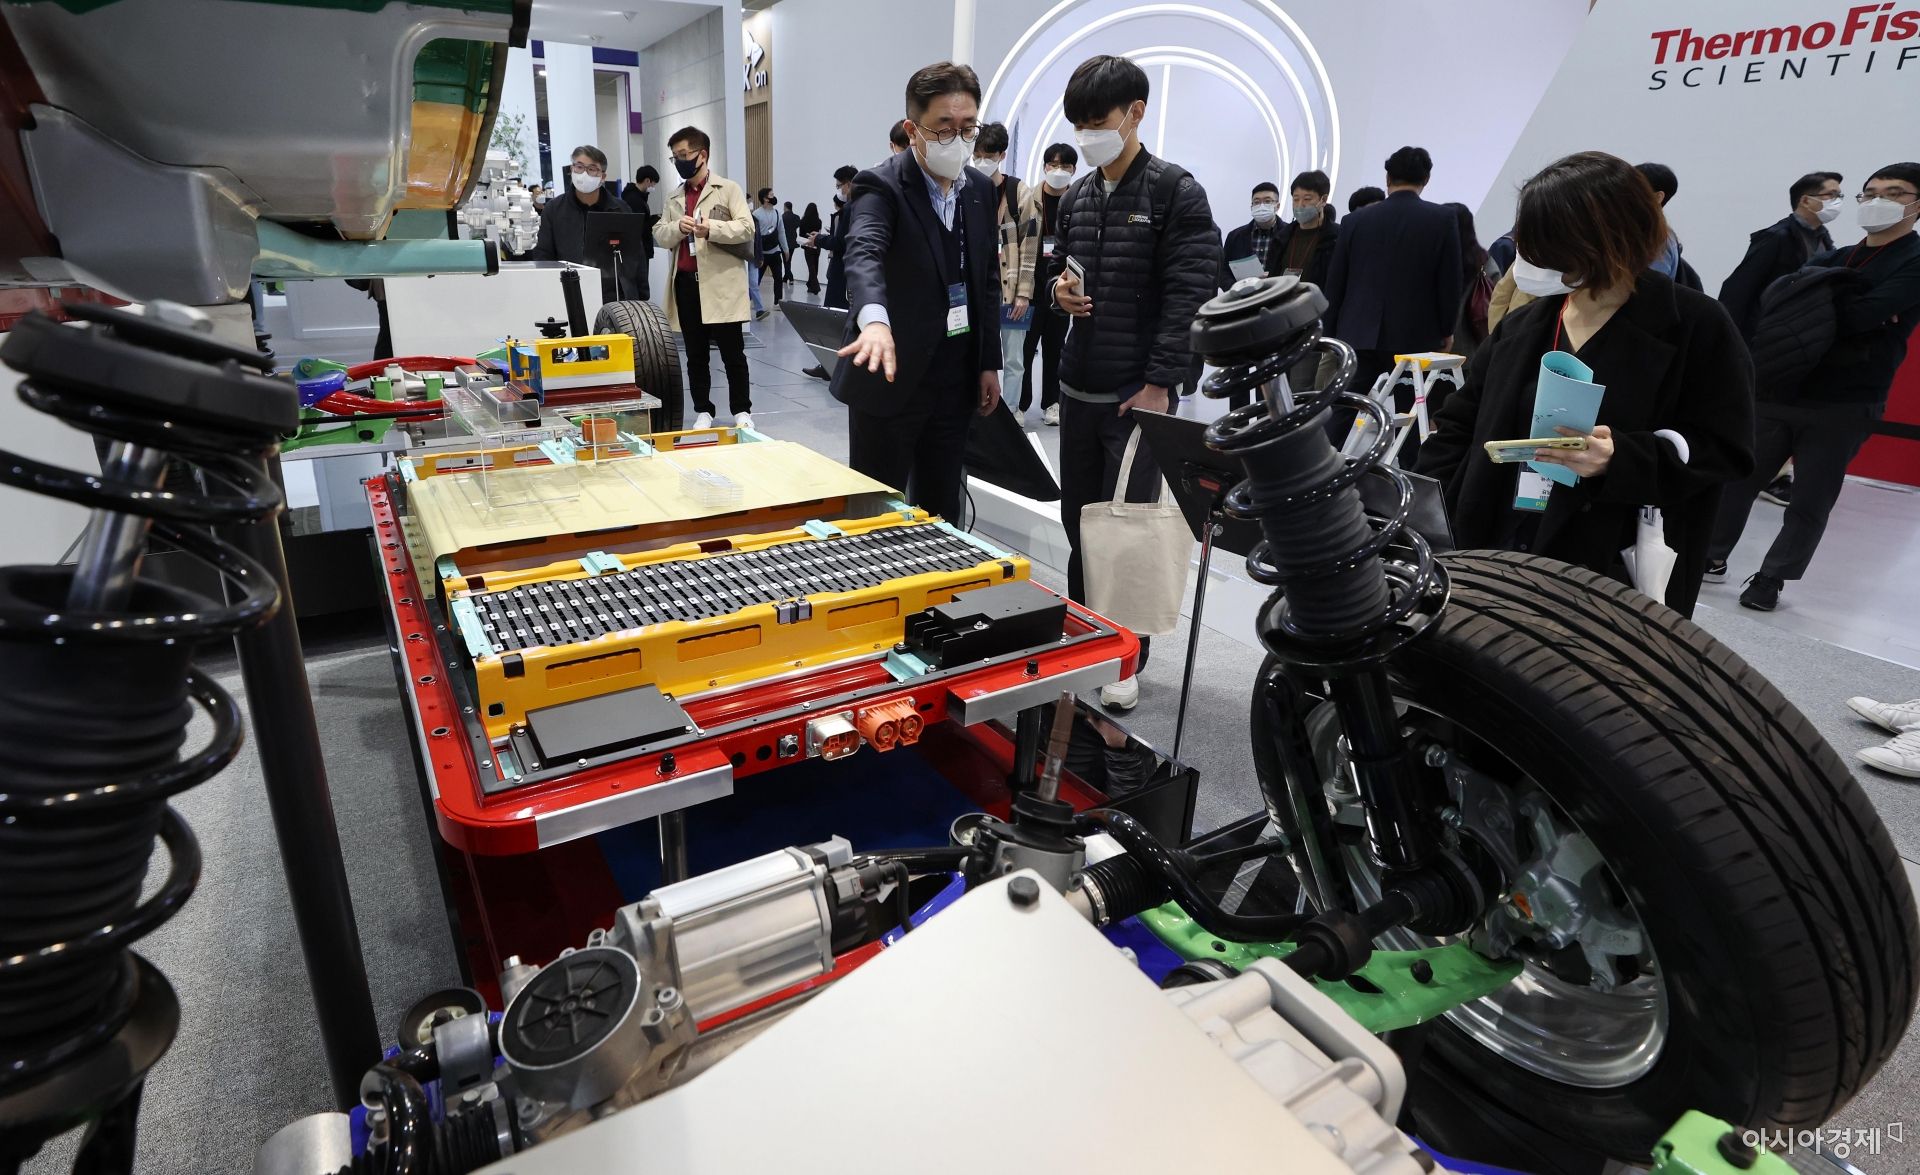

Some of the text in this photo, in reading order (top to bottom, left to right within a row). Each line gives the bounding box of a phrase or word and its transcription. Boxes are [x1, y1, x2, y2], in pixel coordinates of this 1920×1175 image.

[1650, 2, 1920, 65] Thermo Fis
[755, 70, 768, 88] on
[1648, 46, 1920, 91] SCIENTIF
